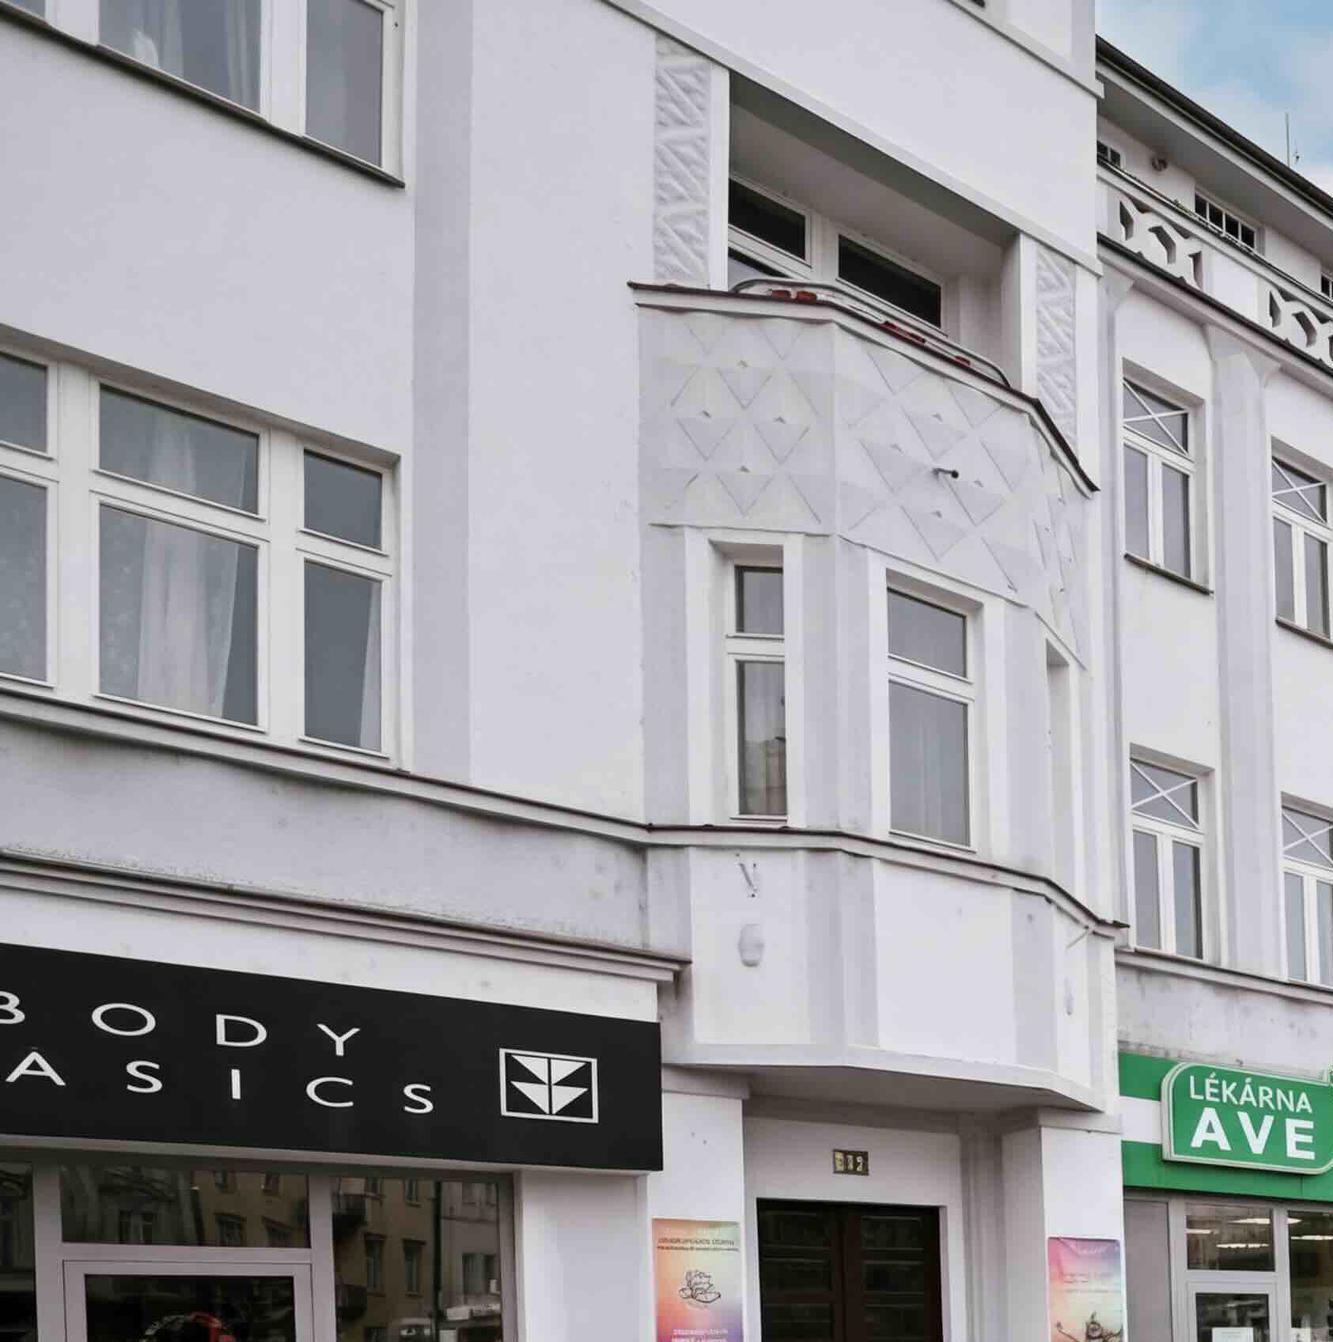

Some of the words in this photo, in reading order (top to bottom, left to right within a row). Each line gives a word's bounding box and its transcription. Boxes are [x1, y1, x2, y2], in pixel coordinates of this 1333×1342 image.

[0, 990, 361, 1057] BODY
[1189, 1072, 1313, 1114] LÉKÁRNA
[1190, 1106, 1316, 1160] AVE
